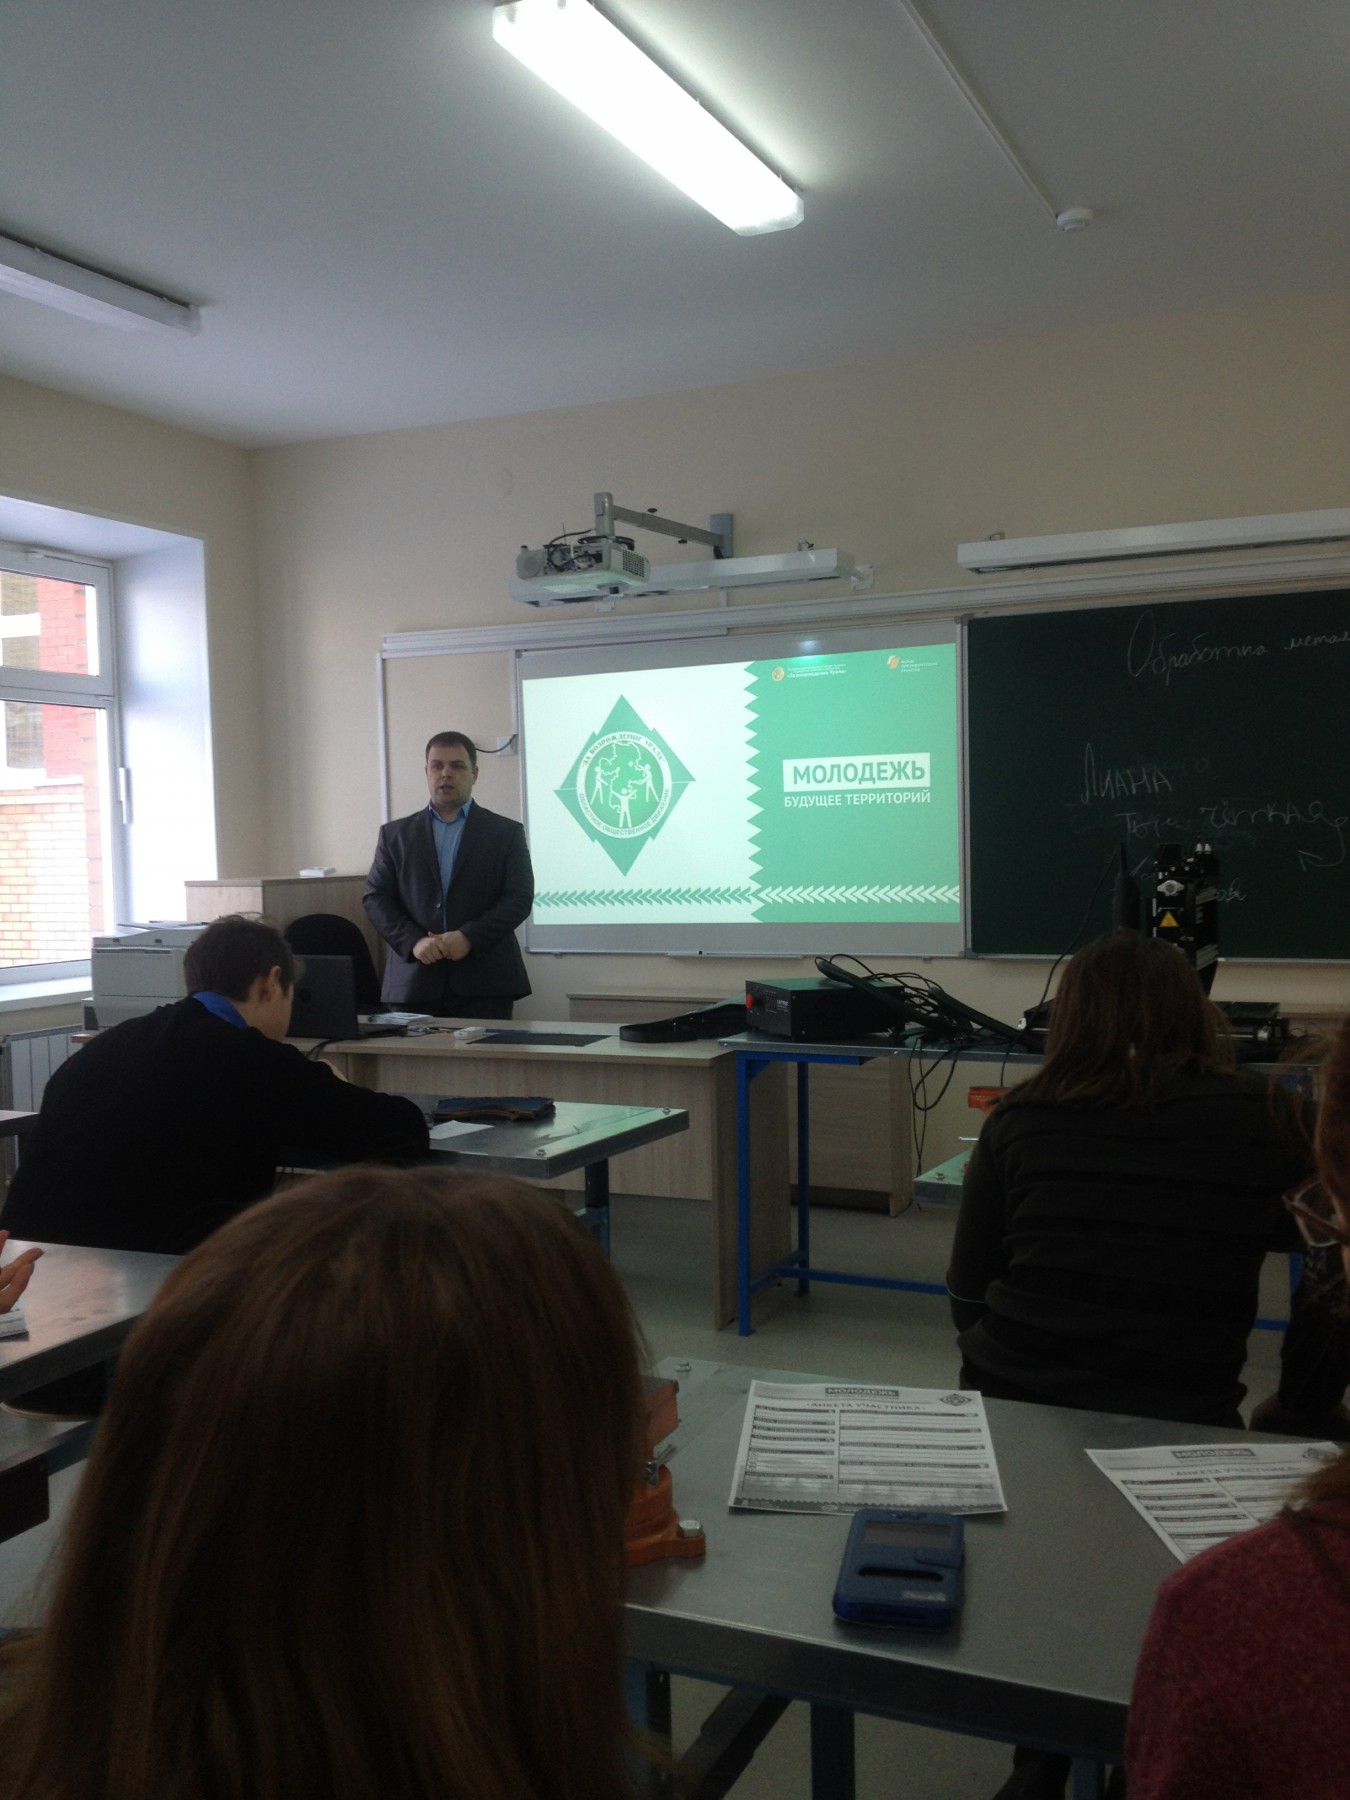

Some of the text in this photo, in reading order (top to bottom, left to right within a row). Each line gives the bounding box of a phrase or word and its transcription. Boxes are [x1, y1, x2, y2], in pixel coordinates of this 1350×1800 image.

[793, 760, 926, 785] МОЛОДЕЖЬ
[784, 789, 931, 809] БУДУЩЕЕ ТЕРРИТОРИЙ
[578, 792, 602, 827] ОБЛАСТНОЕ
[602, 818, 652, 836] ОБЩЕСТВЕННОЕ
